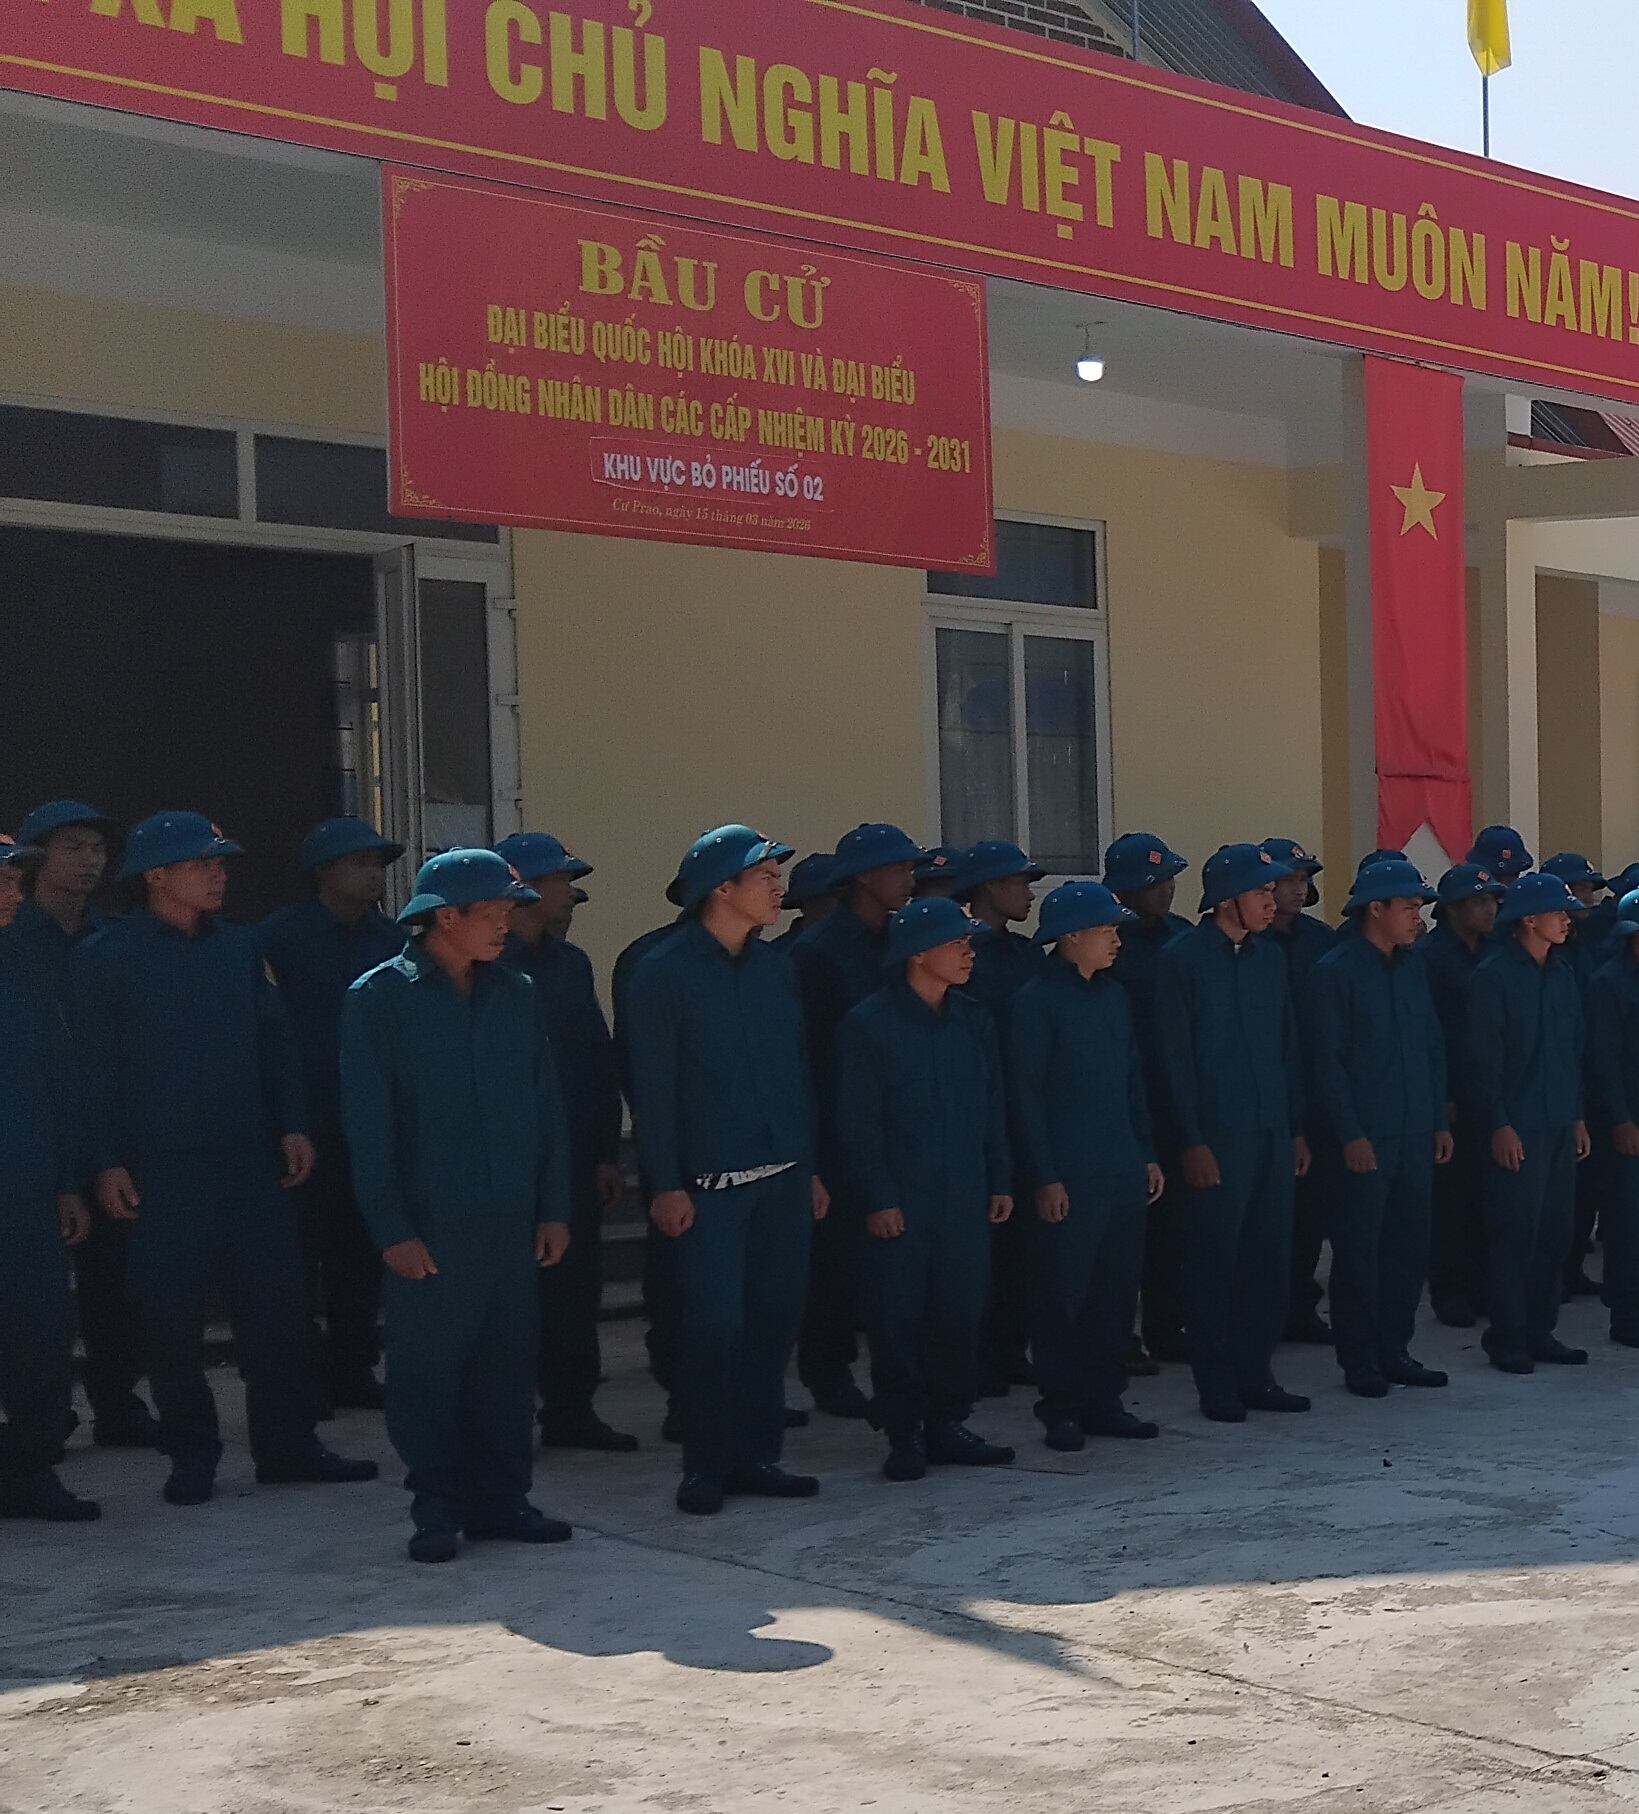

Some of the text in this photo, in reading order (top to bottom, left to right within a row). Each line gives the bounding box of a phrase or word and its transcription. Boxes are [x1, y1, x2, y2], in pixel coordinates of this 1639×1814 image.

[485, 0, 667, 130] CHỦ
[699, 46, 951, 193] NGHĨA
[972, 110, 1121, 241] VIỆT
[1144, 152, 1294, 267] NAM
[1316, 194, 1487, 310] MUÔN
[578, 233, 832, 329] BẦU CỬ
[487, 301, 915, 406] ĐẠI BIỂU QUỐC HỘI KHÓA XVI VÀ ĐẠI BIỂU
[419, 357, 459, 413] HỘI
[466, 358, 531, 414] ĐỒNG
[538, 375, 602, 424] NHÂN
[608, 383, 654, 430] DÂN
[660, 390, 704, 437] CÁC
[710, 393, 751, 444] CẤP
[757, 407, 825, 459] NHIỆM
[830, 414, 855, 456] KỲ
[861, 426, 908, 465] 2026
[927, 434, 971, 474] 2031
[603, 453, 823, 501] KHU VỰC BỎ PHIẾU SỐ 02
[666, 505, 693, 520] ngày
[696, 507, 708, 520] 15
[711, 509, 743, 525] tháng
[760, 515, 784, 527] năm
[786, 518, 811, 530] 2026
